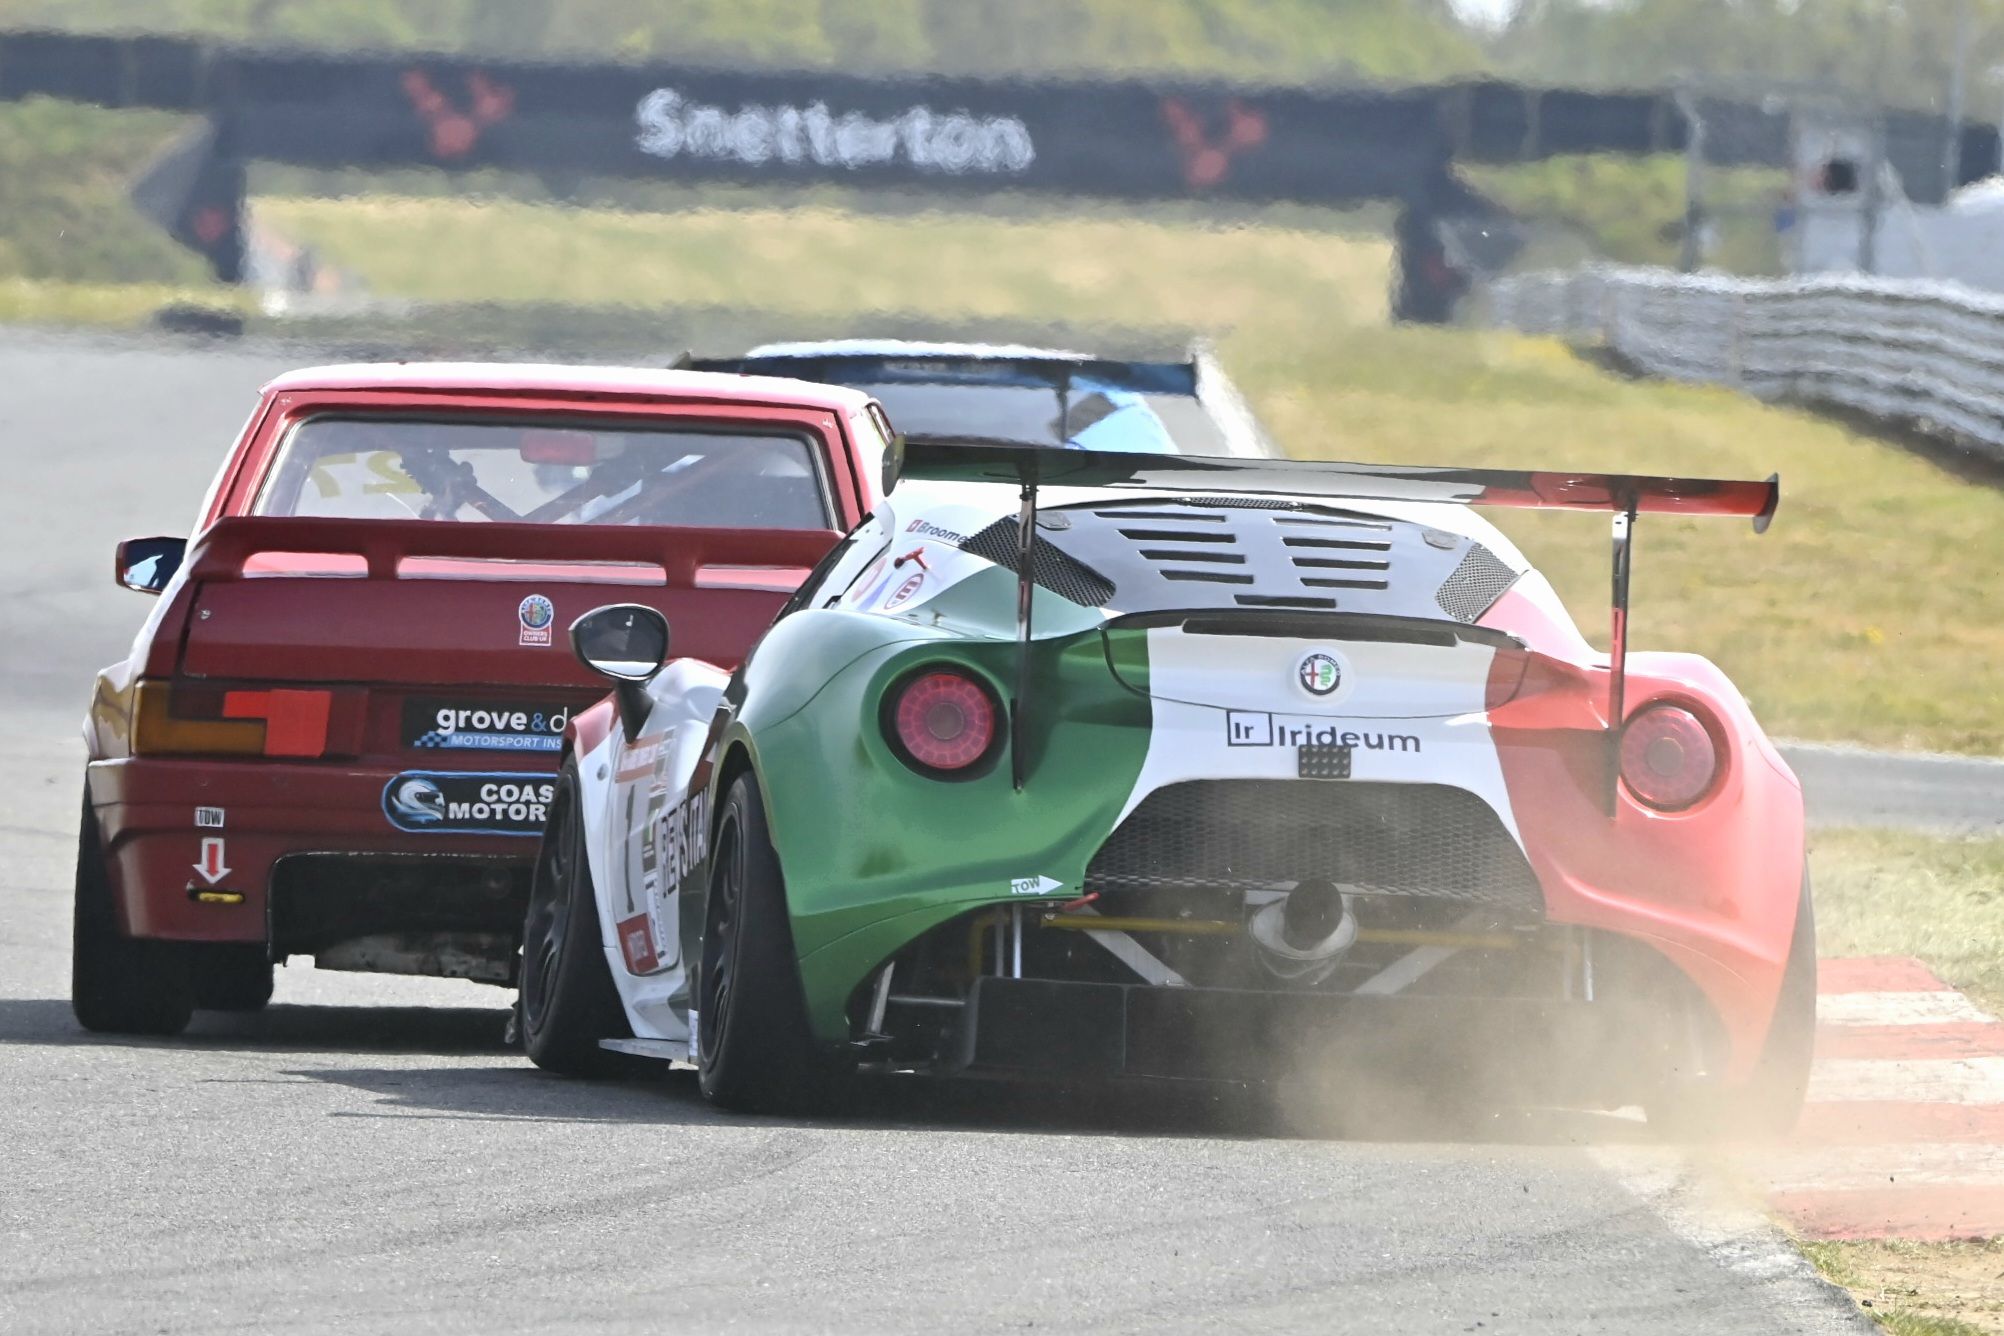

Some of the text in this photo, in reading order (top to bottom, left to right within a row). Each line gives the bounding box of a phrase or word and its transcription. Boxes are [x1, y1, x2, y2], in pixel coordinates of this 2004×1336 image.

[635, 86, 1036, 172] Snetterton
[1235, 721, 1255, 740] Ir
[1278, 724, 1421, 753] Irideum
[452, 734, 563, 749] MOTORSPORT INS
[480, 783, 555, 803] COAS
[198, 809, 222, 826] TOW
[448, 802, 552, 822] MOTOR
[1011, 878, 1041, 894] TOW
